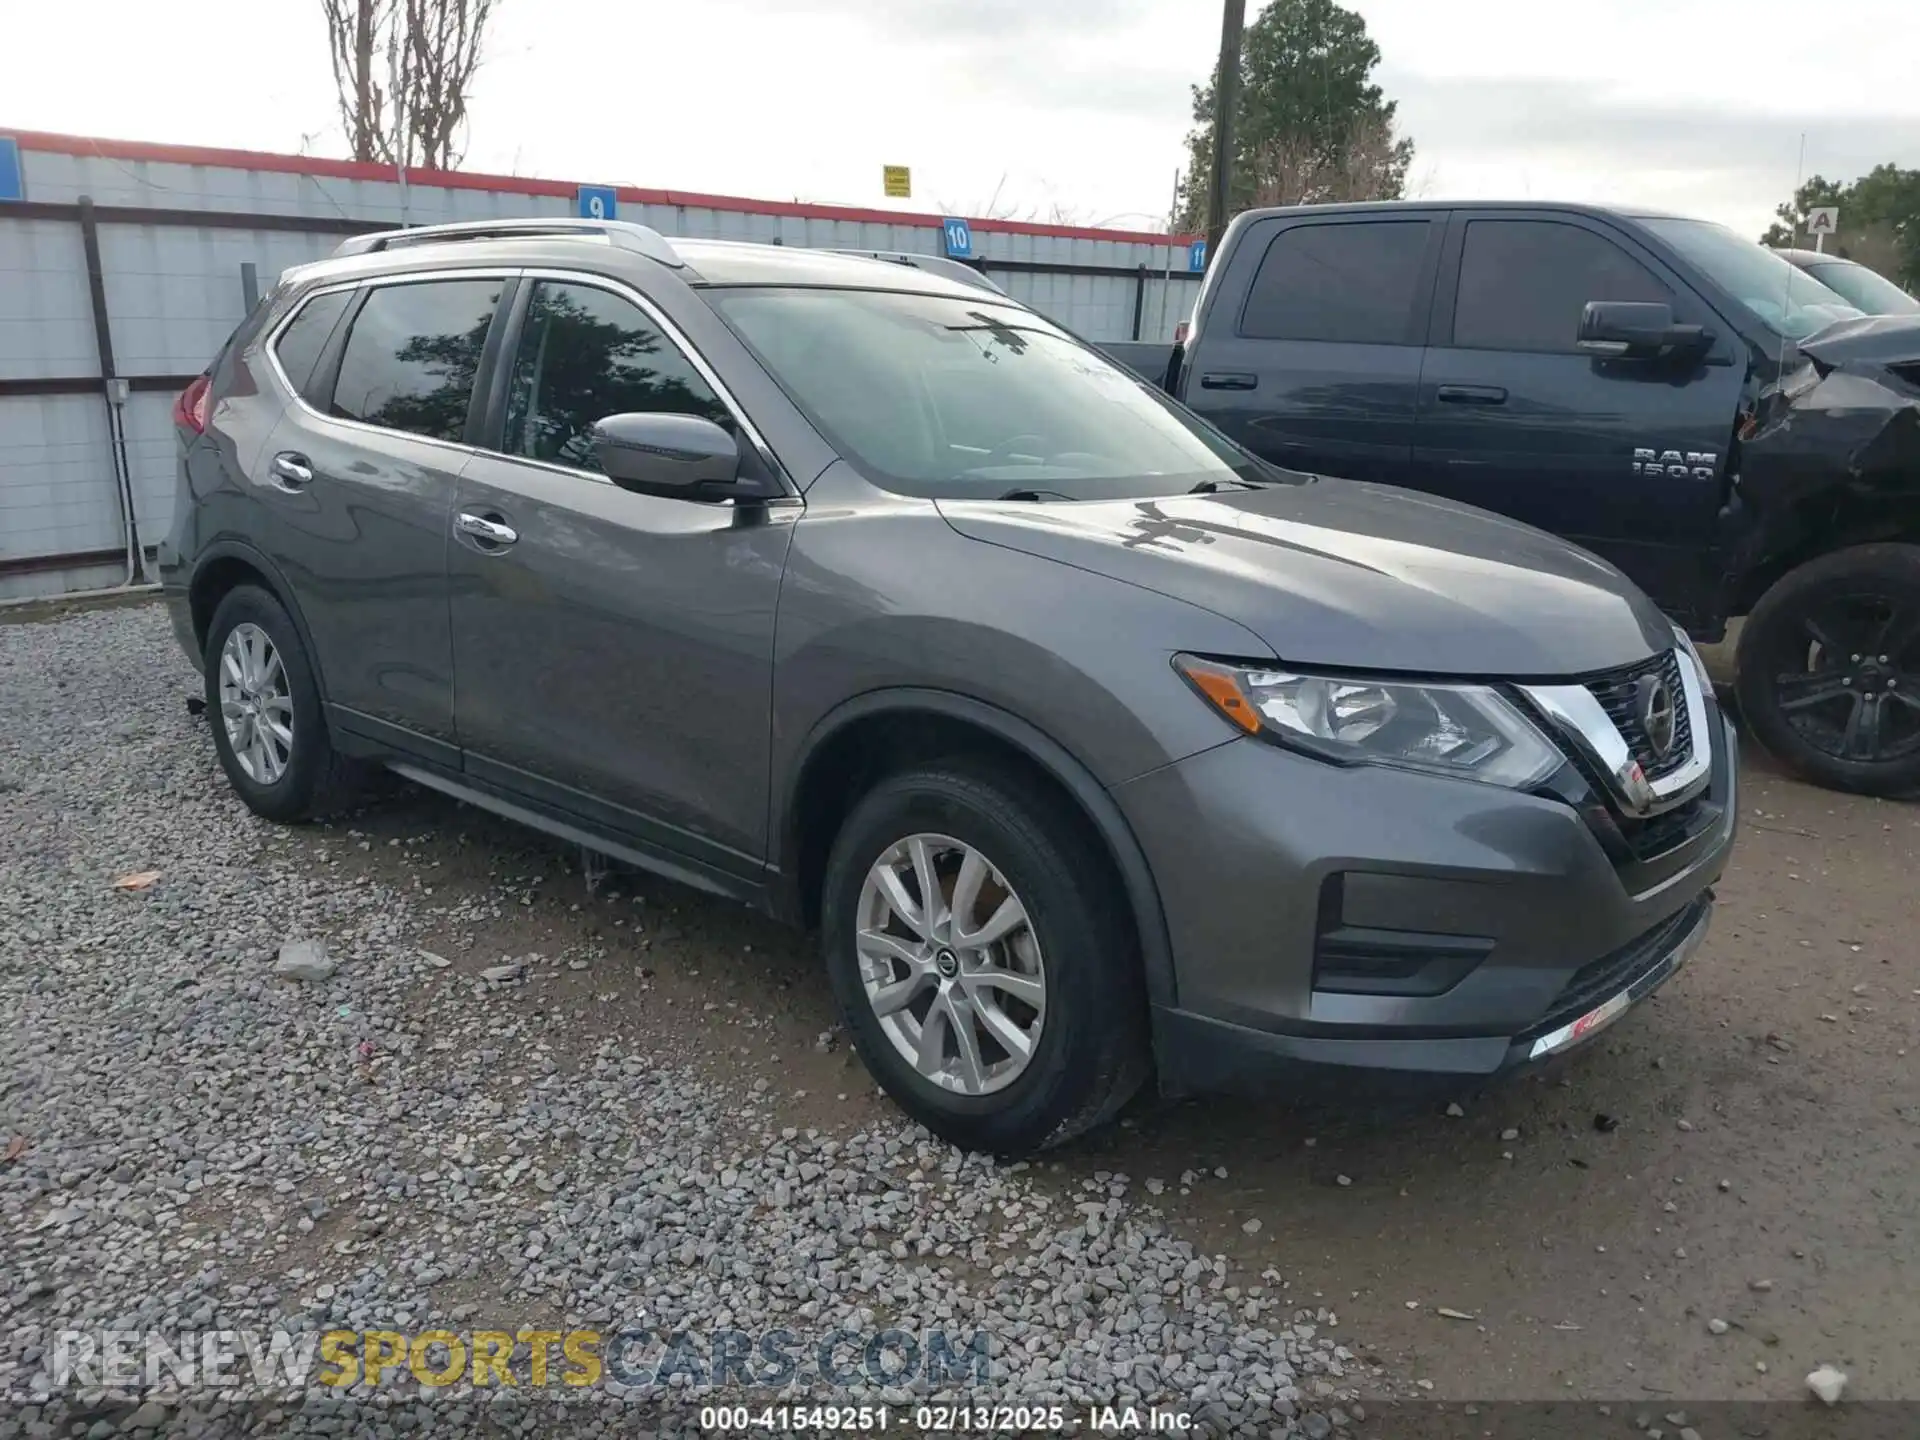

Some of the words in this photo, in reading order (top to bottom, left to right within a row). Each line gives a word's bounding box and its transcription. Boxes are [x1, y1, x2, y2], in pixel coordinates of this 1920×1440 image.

[590, 196, 604, 219] 9
[1813, 211, 1831, 229] A
[948, 225, 967, 249] 10
[1633, 447, 1717, 465] RAM
[1631, 461, 1714, 480] 1500
